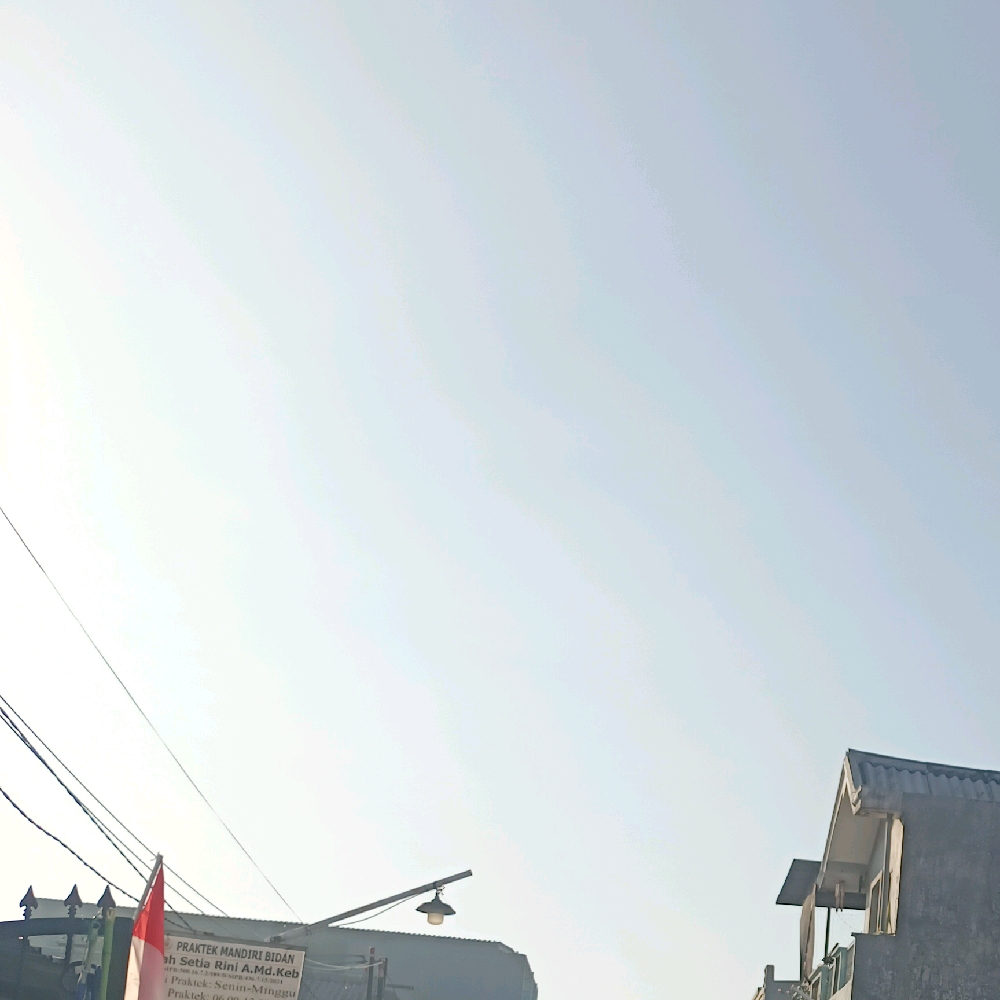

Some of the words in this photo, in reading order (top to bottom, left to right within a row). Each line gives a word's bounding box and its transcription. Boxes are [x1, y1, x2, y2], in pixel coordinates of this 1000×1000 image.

[177, 942, 218, 956] PRAKTEK
[220, 946, 263, 961] MANDIRI
[265, 951, 295, 965] BIDAN
[180, 957, 210, 969] Setia
[215, 960, 239, 973] Rini
[241, 964, 299, 979] A.Md.Keb
[171, 976, 212, 988] Praktek:
[214, 980, 296, 998] Senin-Minggu
